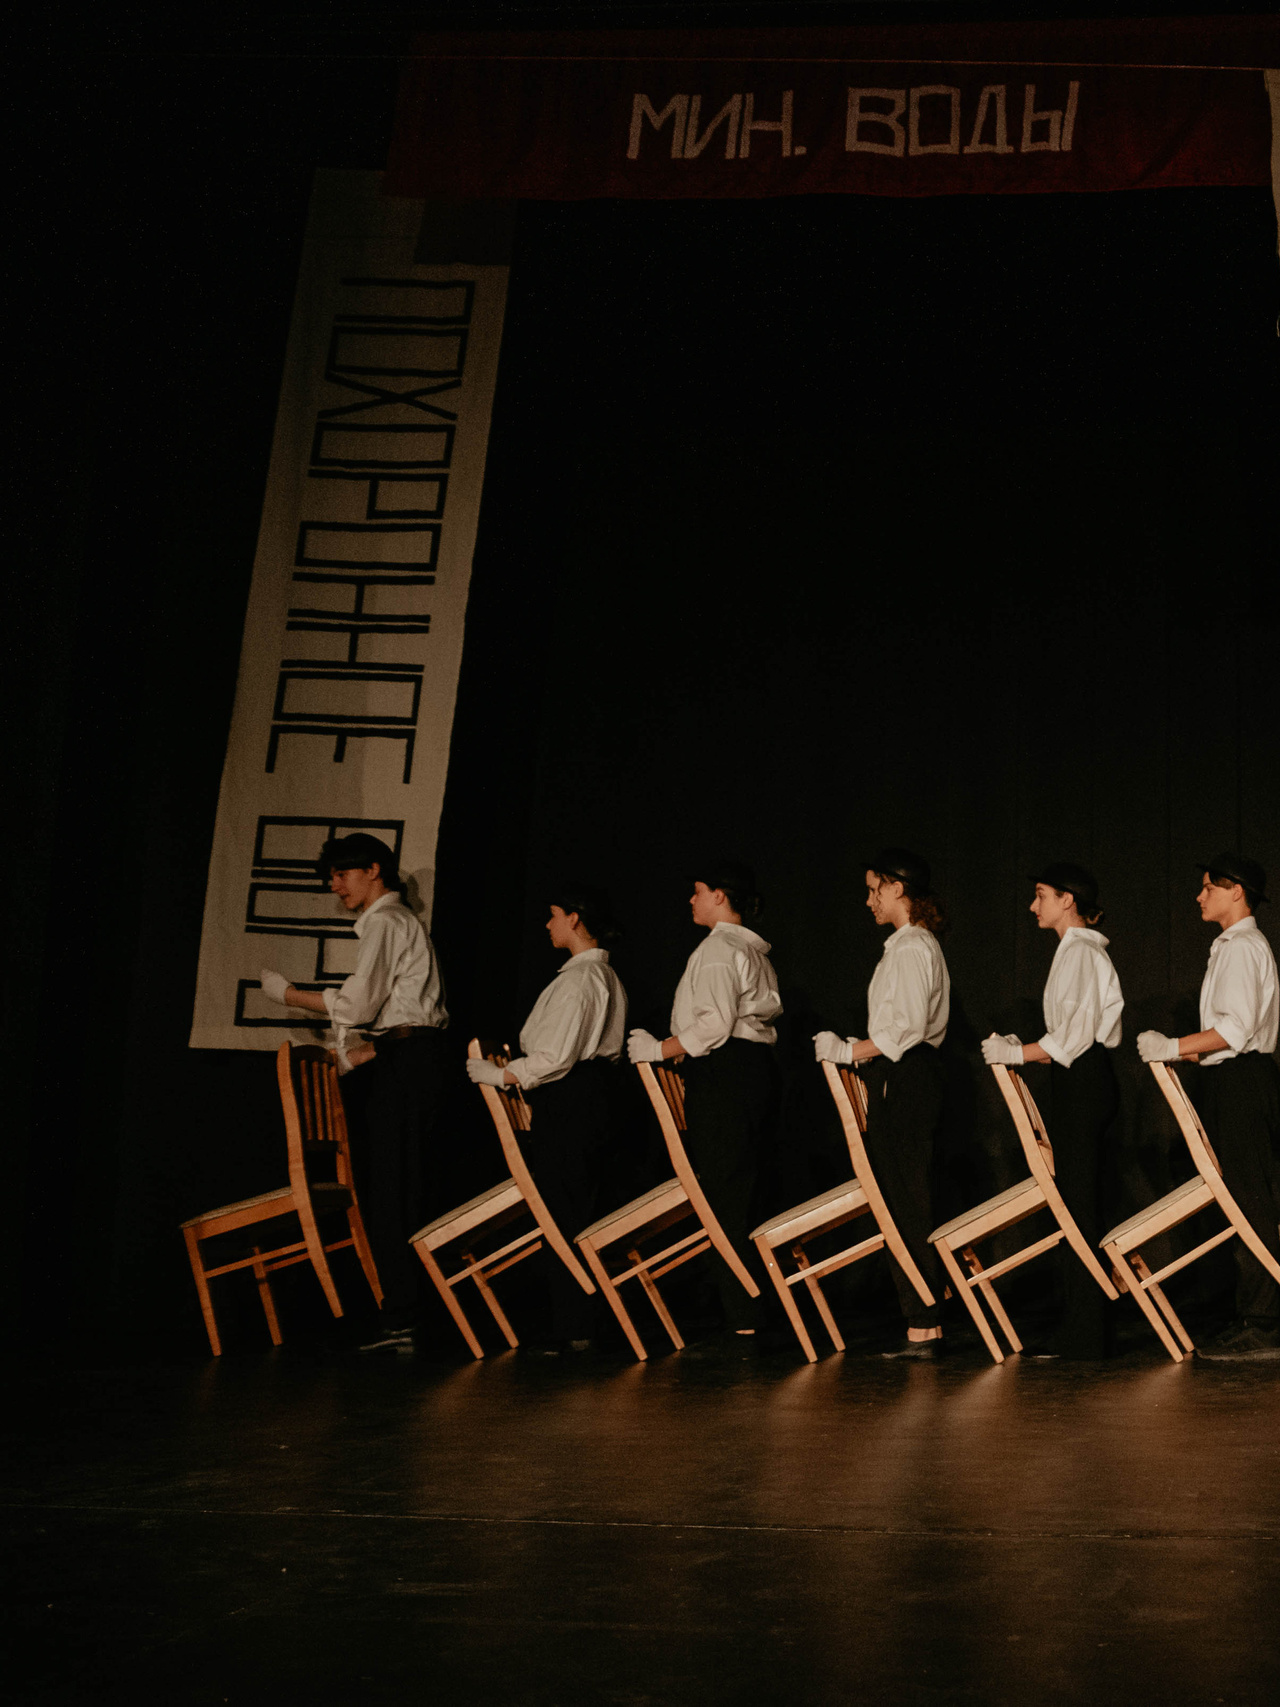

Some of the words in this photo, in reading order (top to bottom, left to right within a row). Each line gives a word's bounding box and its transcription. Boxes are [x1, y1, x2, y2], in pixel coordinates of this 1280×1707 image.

[626, 89, 807, 160] МИН.
[845, 80, 1080, 157] ВОДЫ
[265, 277, 475, 784] ПОХОРОННОЕ
